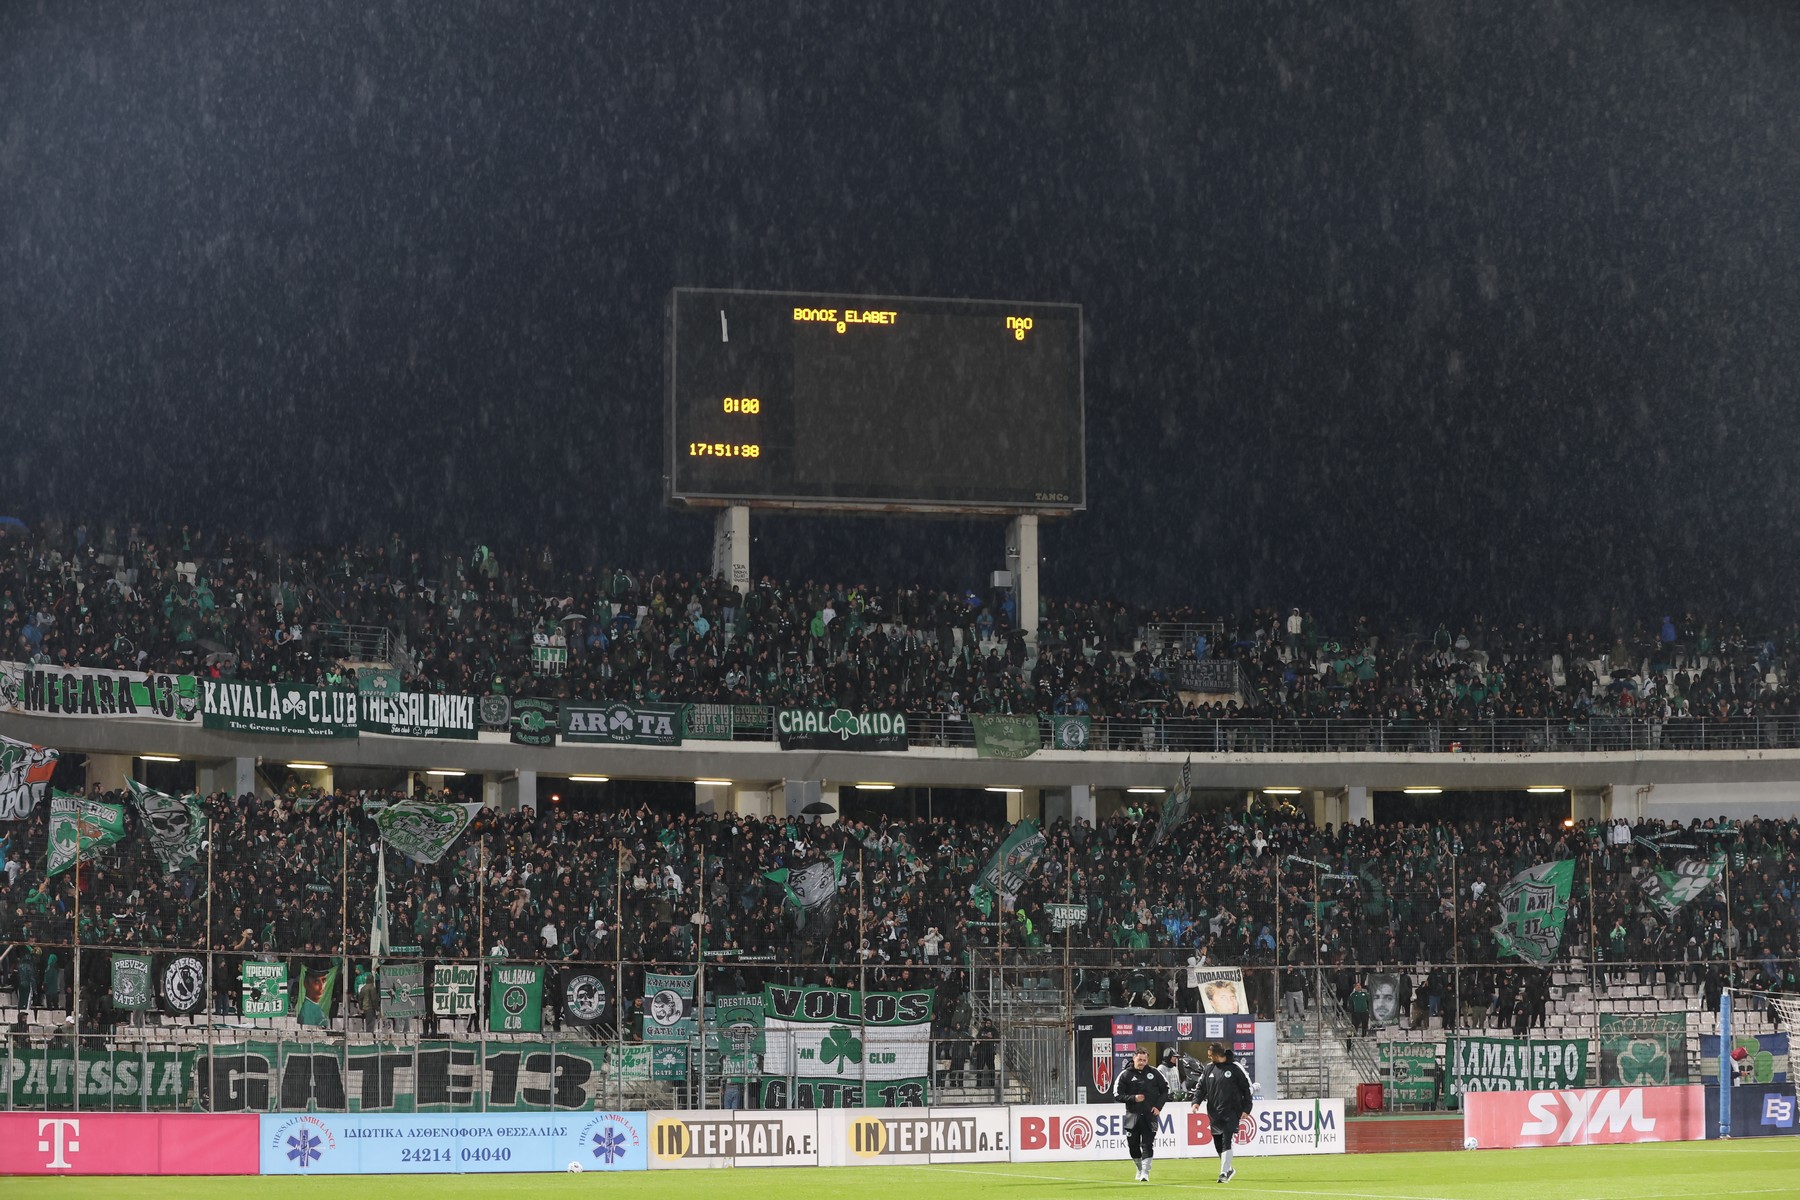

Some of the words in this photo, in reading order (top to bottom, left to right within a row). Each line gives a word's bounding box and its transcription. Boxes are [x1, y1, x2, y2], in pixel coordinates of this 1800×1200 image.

[845, 310, 897, 324] ELABET
[836, 321, 846, 334] 0
[1015, 328, 1025, 340] 0
[723, 397, 760, 414] 0:00
[689, 442, 760, 458] 17:51:38
[24, 670, 138, 715] MEGARA
[143, 674, 176, 718] 13
[203, 680, 282, 721] KAVALA
[308, 690, 358, 724] CLUB
[695, 714, 718, 725] GATE
[249, 723, 280, 733] Greens
[281, 726, 305, 735] From
[308, 727, 334, 736] North
[1054, 907, 1087, 920] ARGOS
[114, 959, 148, 974] PREVEZA
[498, 969, 536, 985] KALABAKA
[718, 996, 763, 1009] ORESTIADA
[769, 986, 931, 1024] VOLOS
[504, 1016, 522, 1029] CLUB
[869, 1052, 896, 1064] CLUB
[1451, 1039, 1579, 1081] ΚΑΜΑΤΕΡΟ
[0, 1057, 184, 1097] PATISSIA
[1258, 1110, 1336, 1132] SERUM
[1520, 1088, 1657, 1144] SYM
[343, 1127, 403, 1138] ΙΔΙΩΤΙΚΑ
[407, 1127, 493, 1138] ΑΣΘΕΝΟΦΟΡΑ
[496, 1126, 568, 1138] ΘΕΣΣΑΛΙΑΣ
[401, 1148, 452, 1162] 24214
[461, 1147, 511, 1162] 04040
